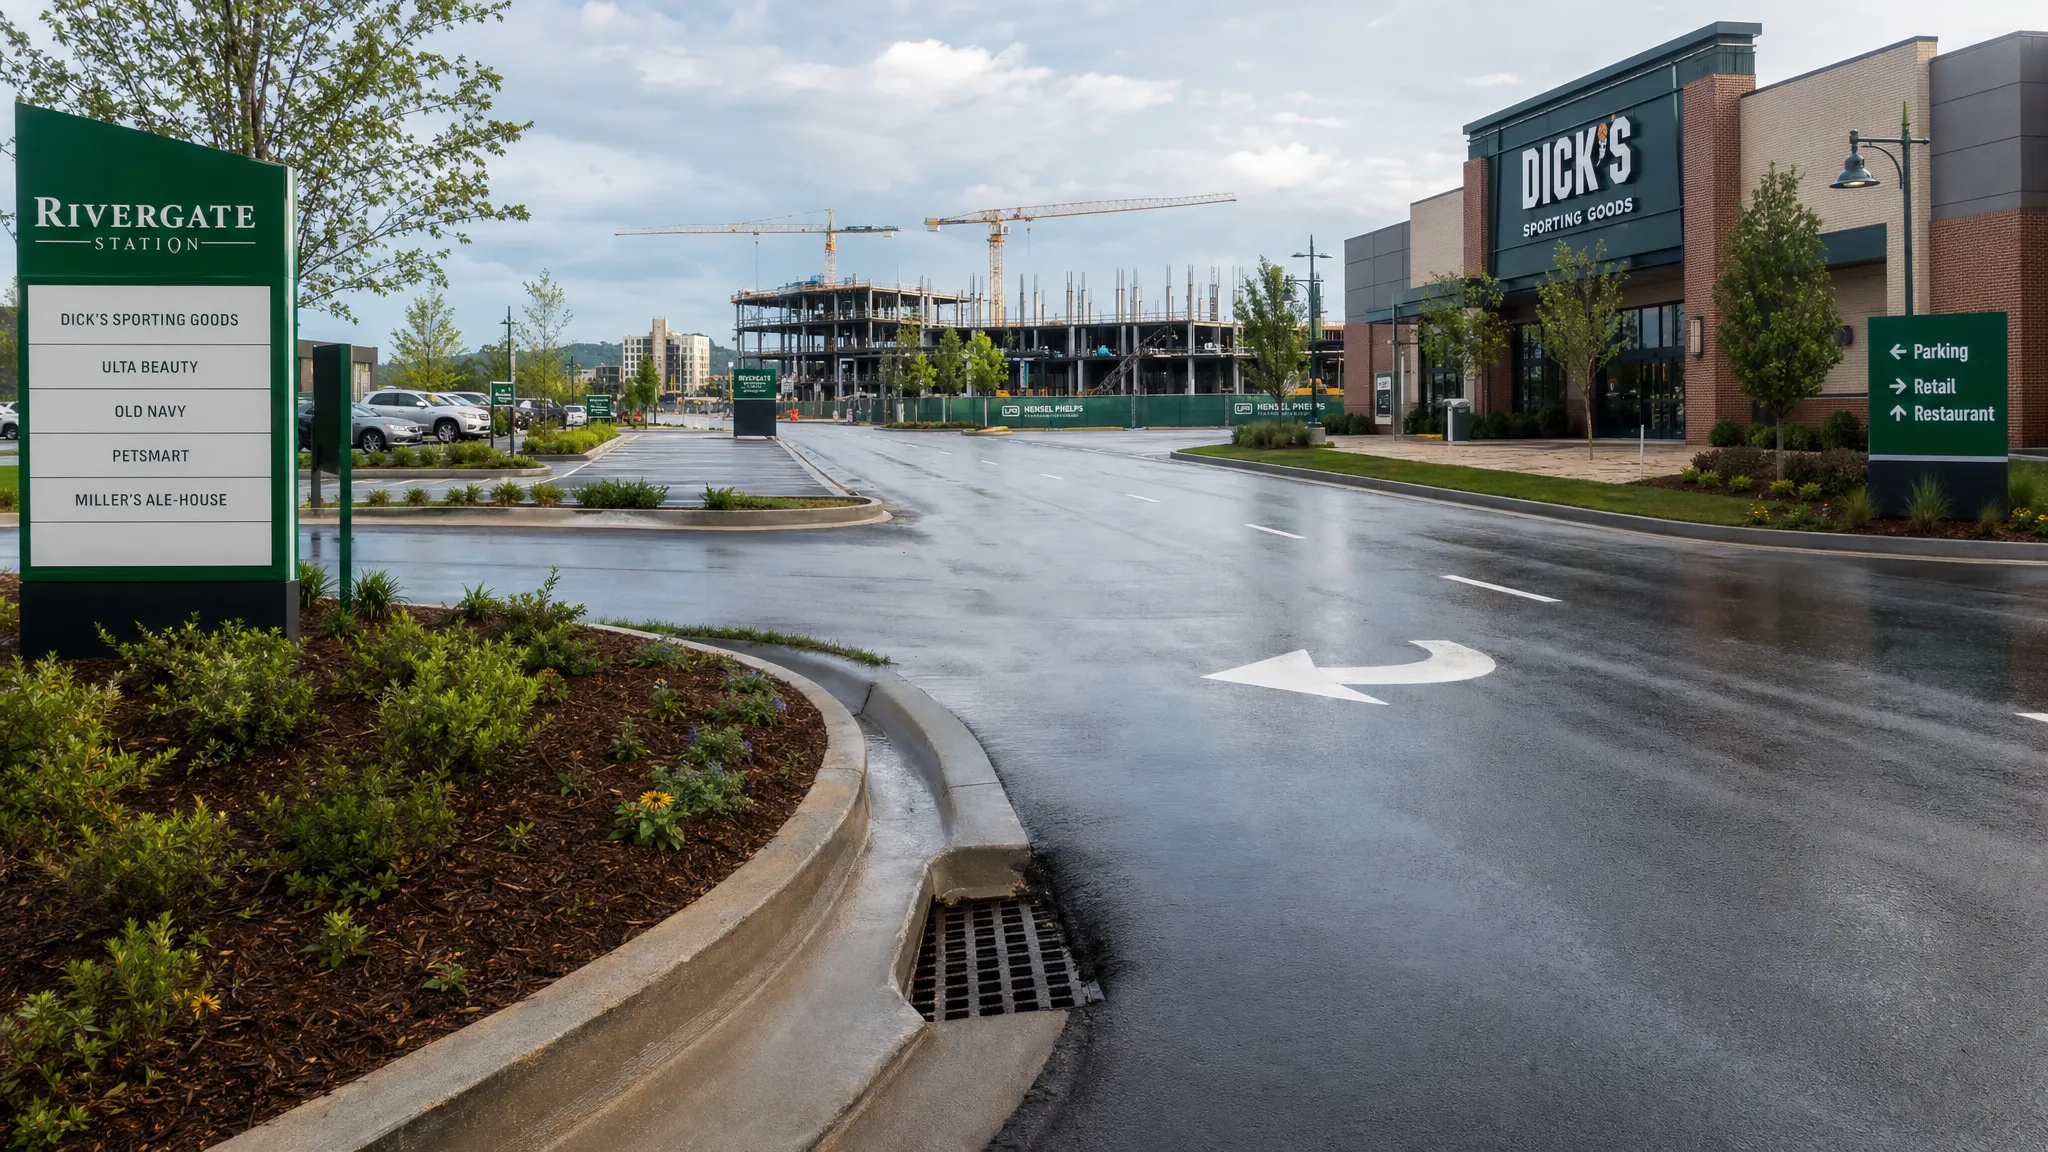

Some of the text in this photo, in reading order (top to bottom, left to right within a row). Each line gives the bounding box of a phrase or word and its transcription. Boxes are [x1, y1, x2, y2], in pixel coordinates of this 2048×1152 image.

[1522, 115, 1631, 209] DICK'S
[1523, 197, 1633, 237] SPORTING GOODS
[94, 236, 199, 254] STATION
[60, 313, 240, 326] DICK'S SPORTING GOODS
[1914, 343, 1969, 362] Parking
[102, 360, 199, 374] ULTA BEAUTY
[1914, 378, 1957, 395] Retail
[114, 405, 187, 418] OLD NAVY
[1914, 405, 1995, 422] Restaurant
[112, 449, 190, 462] PETSMART
[75, 493, 228, 506] MILLER'S ALE-HOUSE
